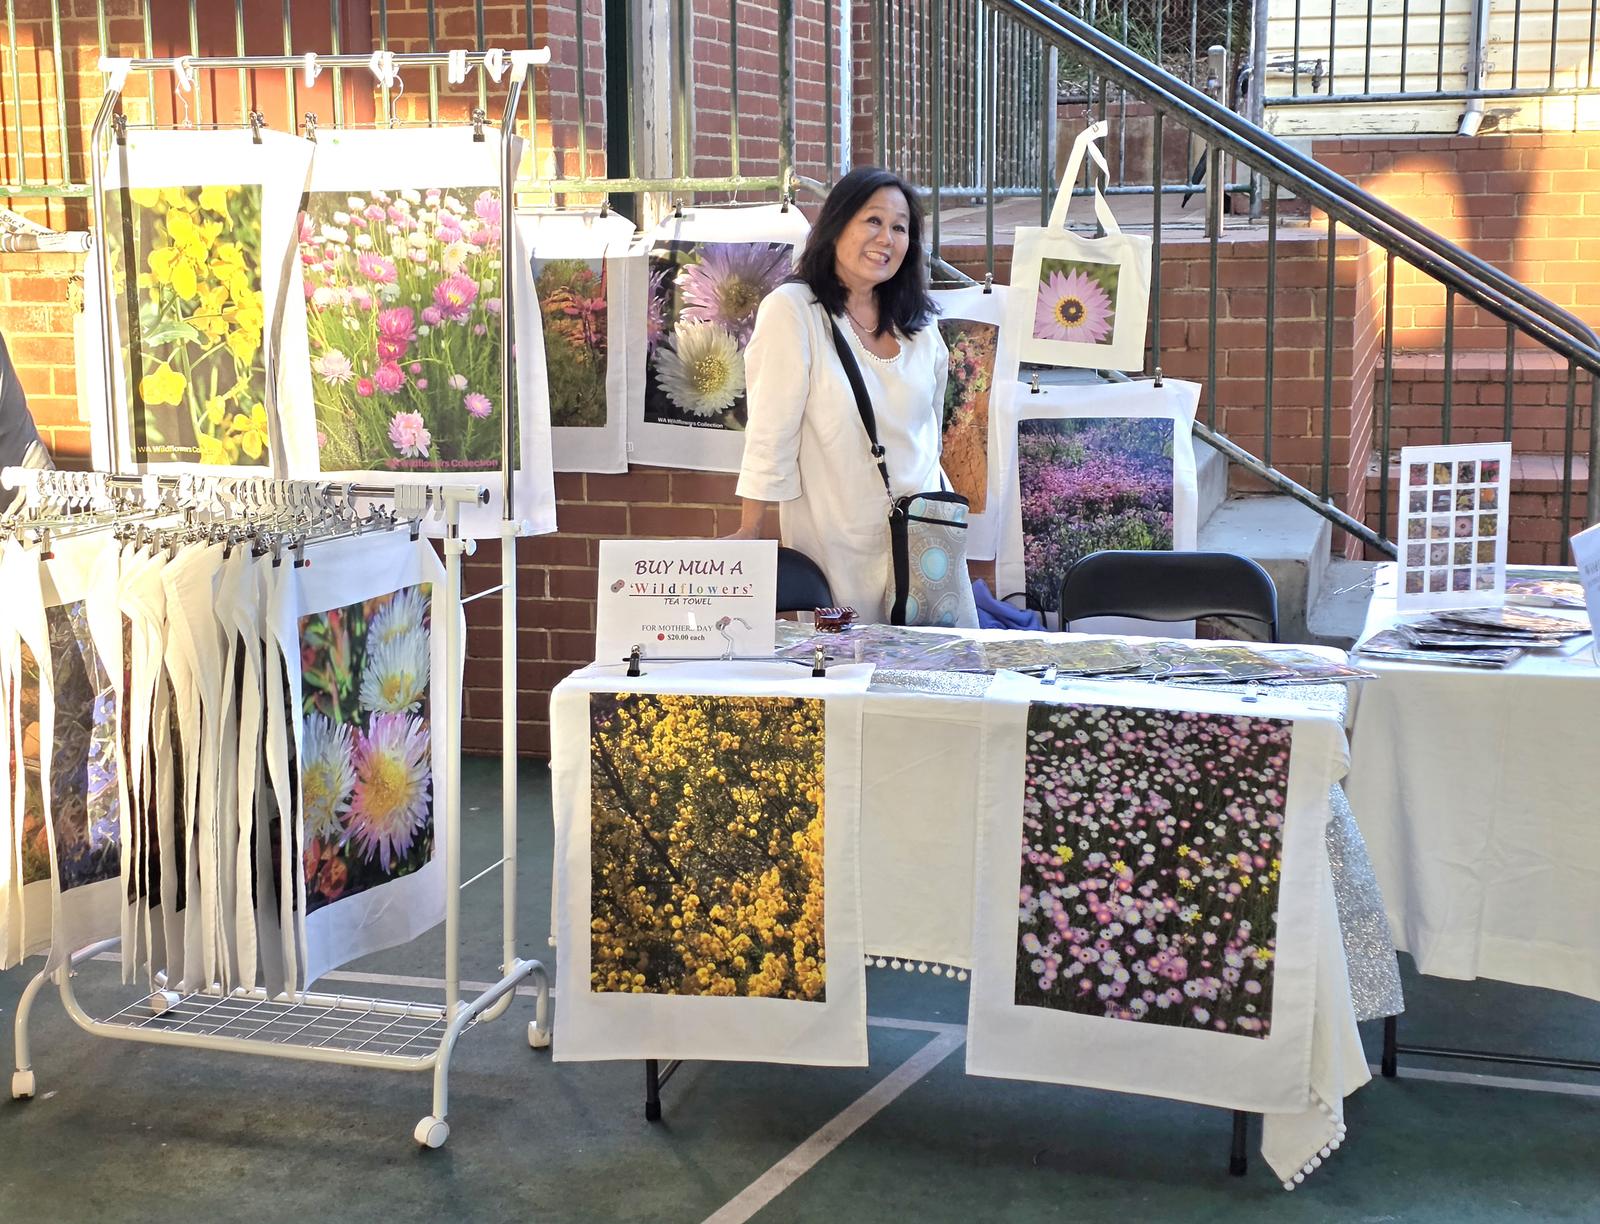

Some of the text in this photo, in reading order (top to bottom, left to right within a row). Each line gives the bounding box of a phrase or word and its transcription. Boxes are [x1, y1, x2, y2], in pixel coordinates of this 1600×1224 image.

[697, 421, 723, 429] Collection
[400, 457, 450, 468] Wildflowrs
[451, 459, 498, 468] Collection
[634, 560, 743, 576] BUY MUM A
[664, 598, 712, 606] TEA TOWEL
[641, 624, 713, 632] FOR MOTHER DAY
[667, 633, 705, 641] $20.00 each
